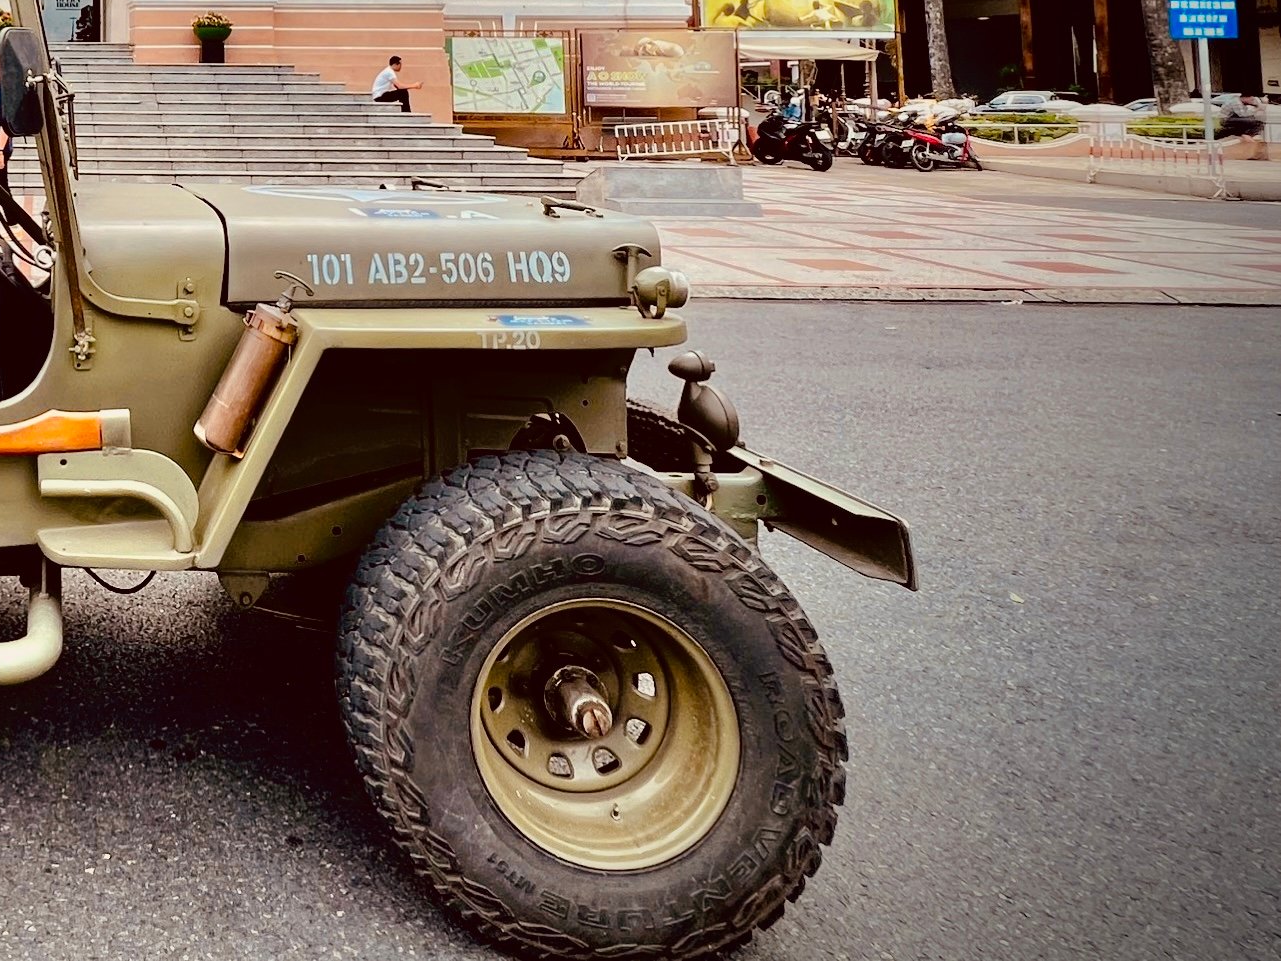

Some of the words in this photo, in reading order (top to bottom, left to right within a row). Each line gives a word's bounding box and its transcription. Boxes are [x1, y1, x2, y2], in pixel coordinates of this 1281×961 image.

[307, 253, 354, 285] 101
[369, 252, 495, 285] AB2-506
[507, 251, 570, 284] HQ9
[475, 330, 541, 350] TP.20
[439, 552, 606, 666] KUMHO
[486, 851, 537, 894] MT51
[539, 827, 783, 930] VENTURE
